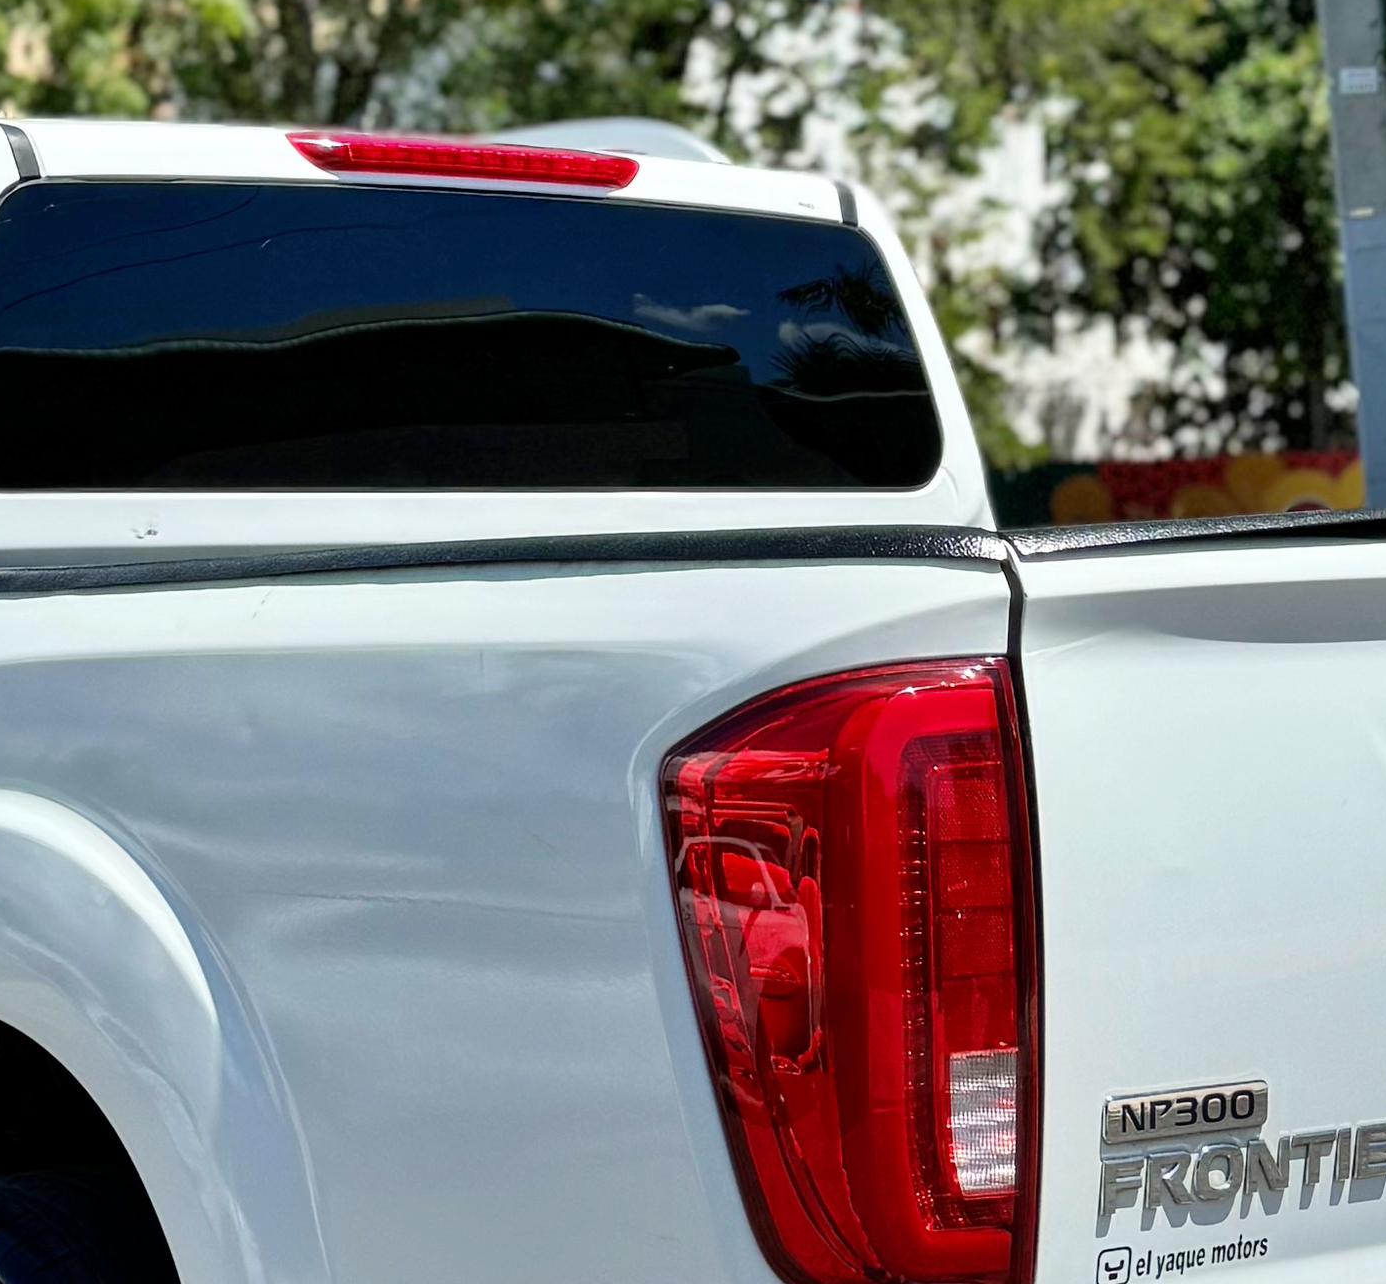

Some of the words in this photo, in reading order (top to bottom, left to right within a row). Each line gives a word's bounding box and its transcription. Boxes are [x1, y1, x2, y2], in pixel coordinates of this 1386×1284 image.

[1120, 1088, 1257, 1134] NP300
[1135, 1249, 1152, 1277] el
[1155, 1247, 1206, 1280] yaque
[1211, 1233, 1269, 1265] motors
